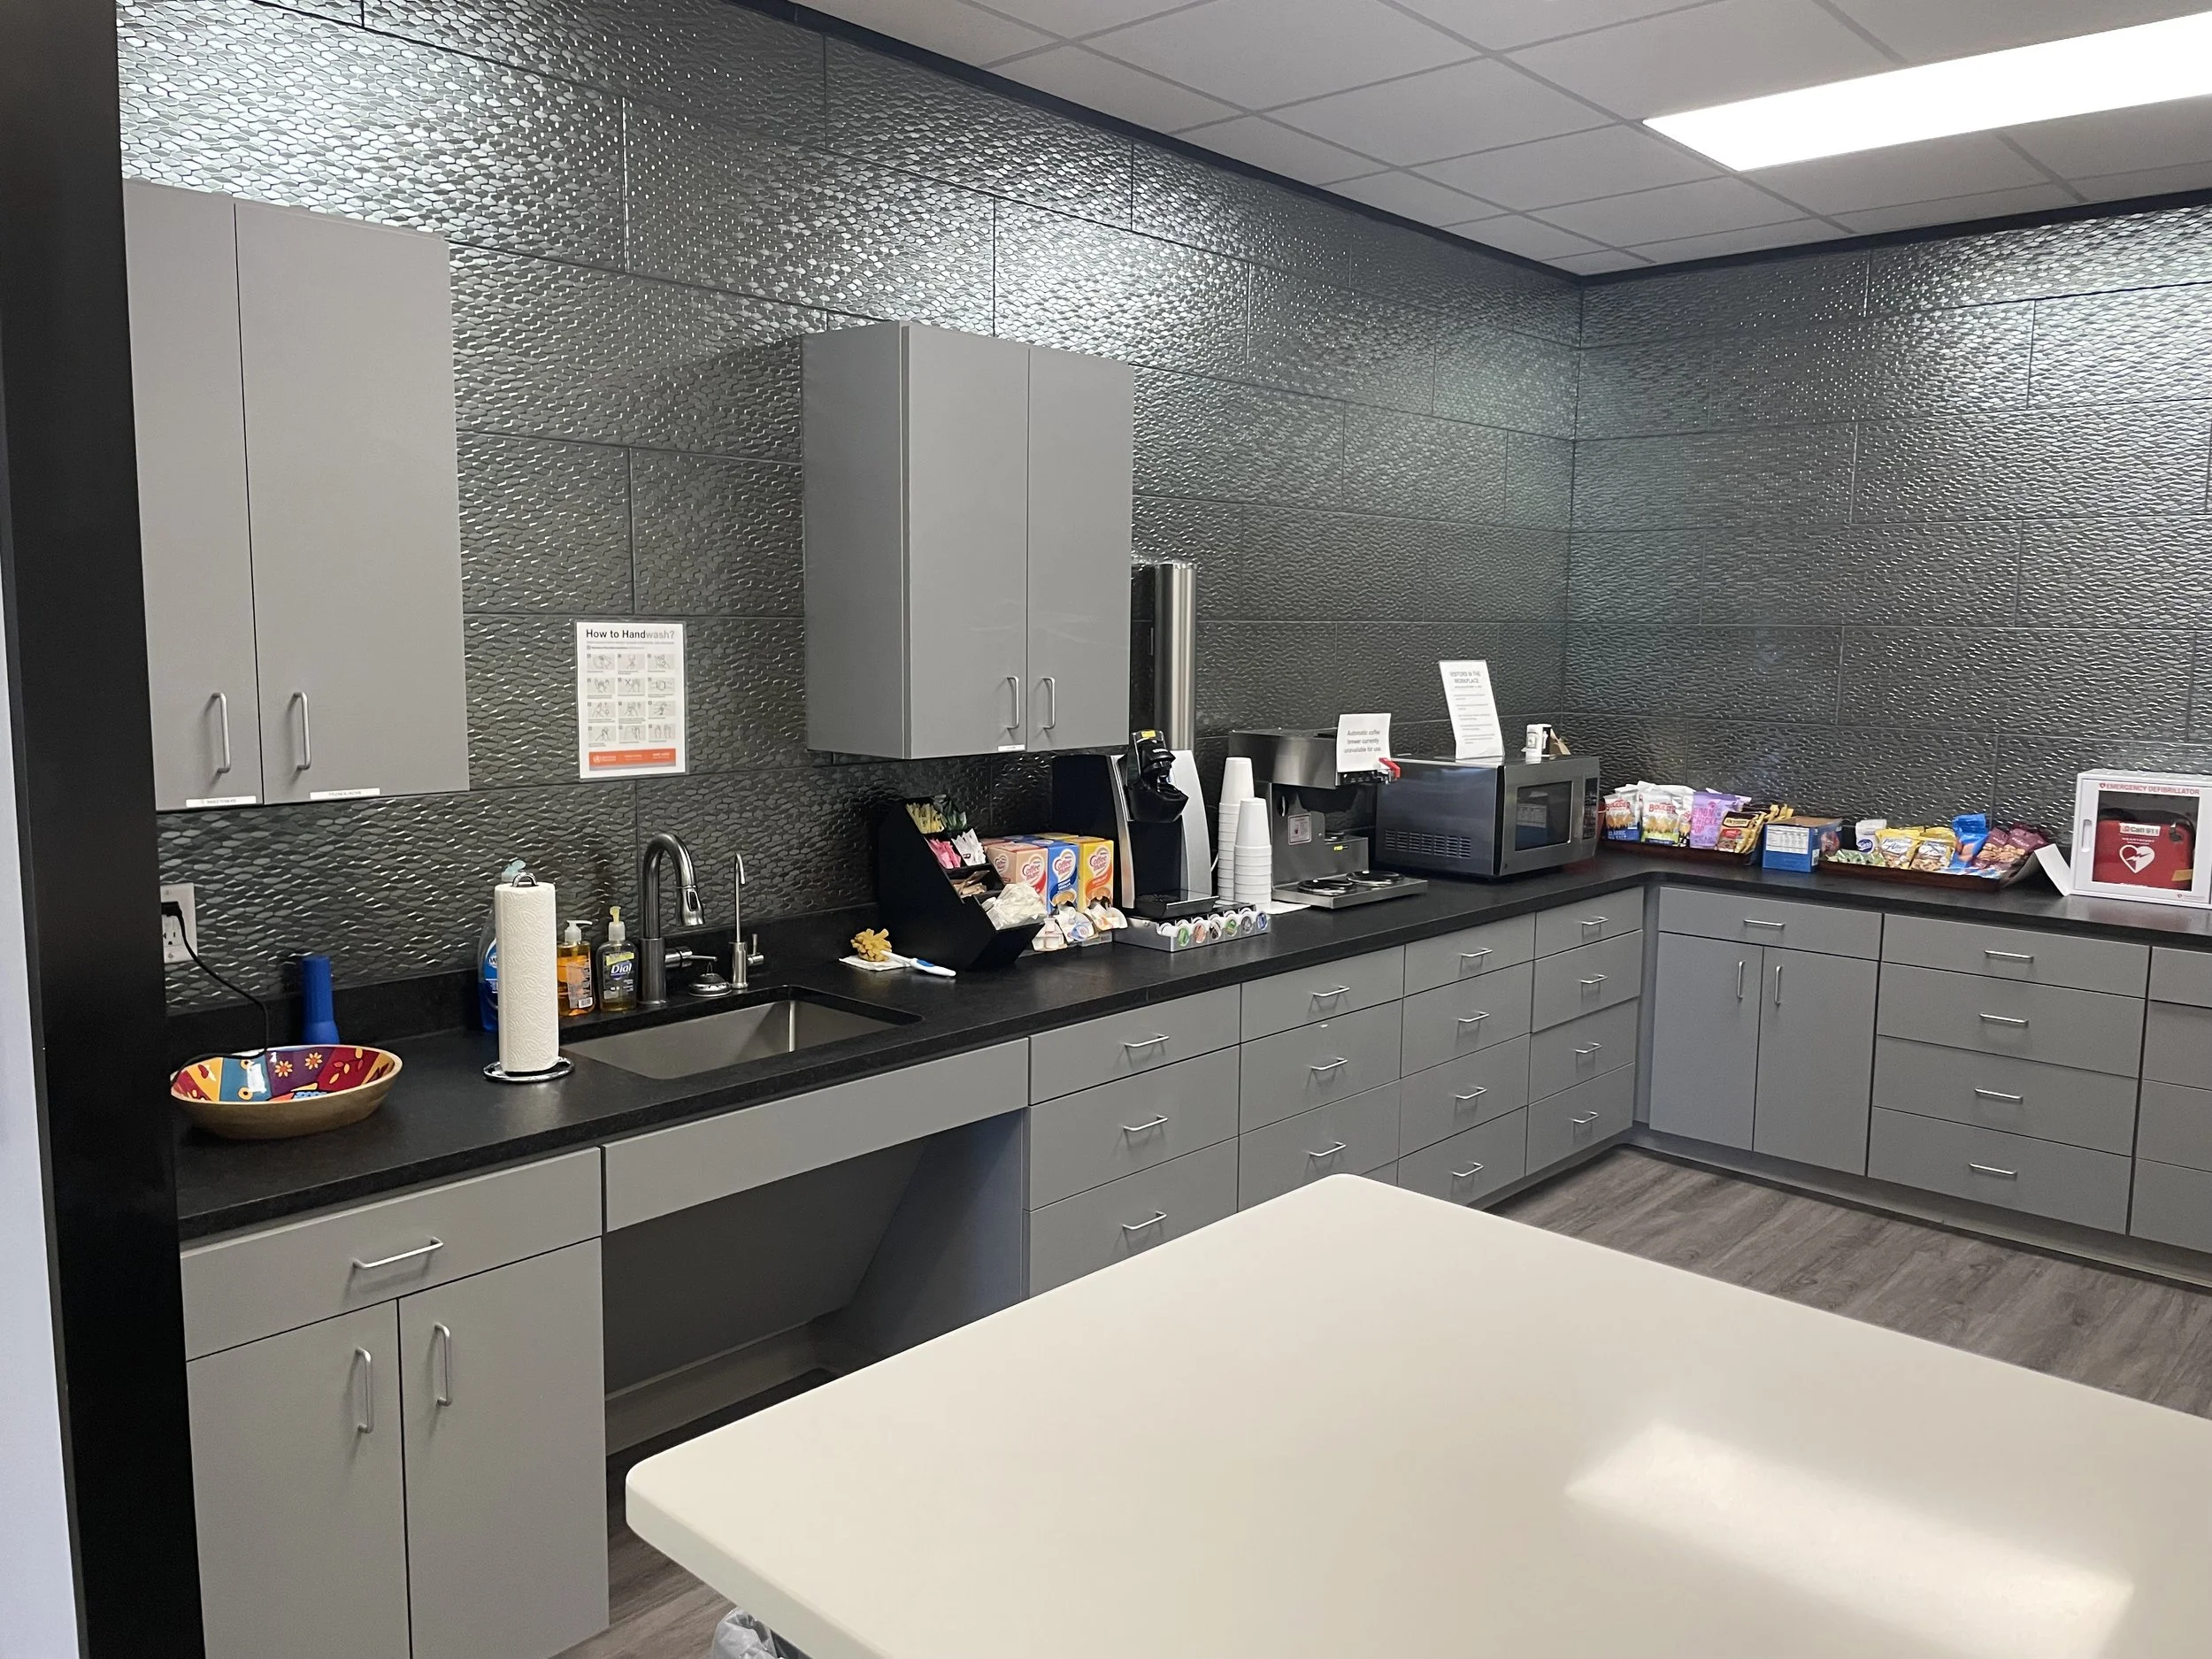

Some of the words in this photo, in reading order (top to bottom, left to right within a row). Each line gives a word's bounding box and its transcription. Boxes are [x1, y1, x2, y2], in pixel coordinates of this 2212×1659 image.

[586, 629, 607, 638] How
[622, 630, 675, 639] Handwash?
[2147, 786, 2200, 795] DEFIBRILLATOR
[1055, 858, 1071, 870] Coffee
[1090, 855, 1107, 866] Coffee
[1023, 864, 1041, 876] Coffee
[611, 962, 633, 974] Dial
